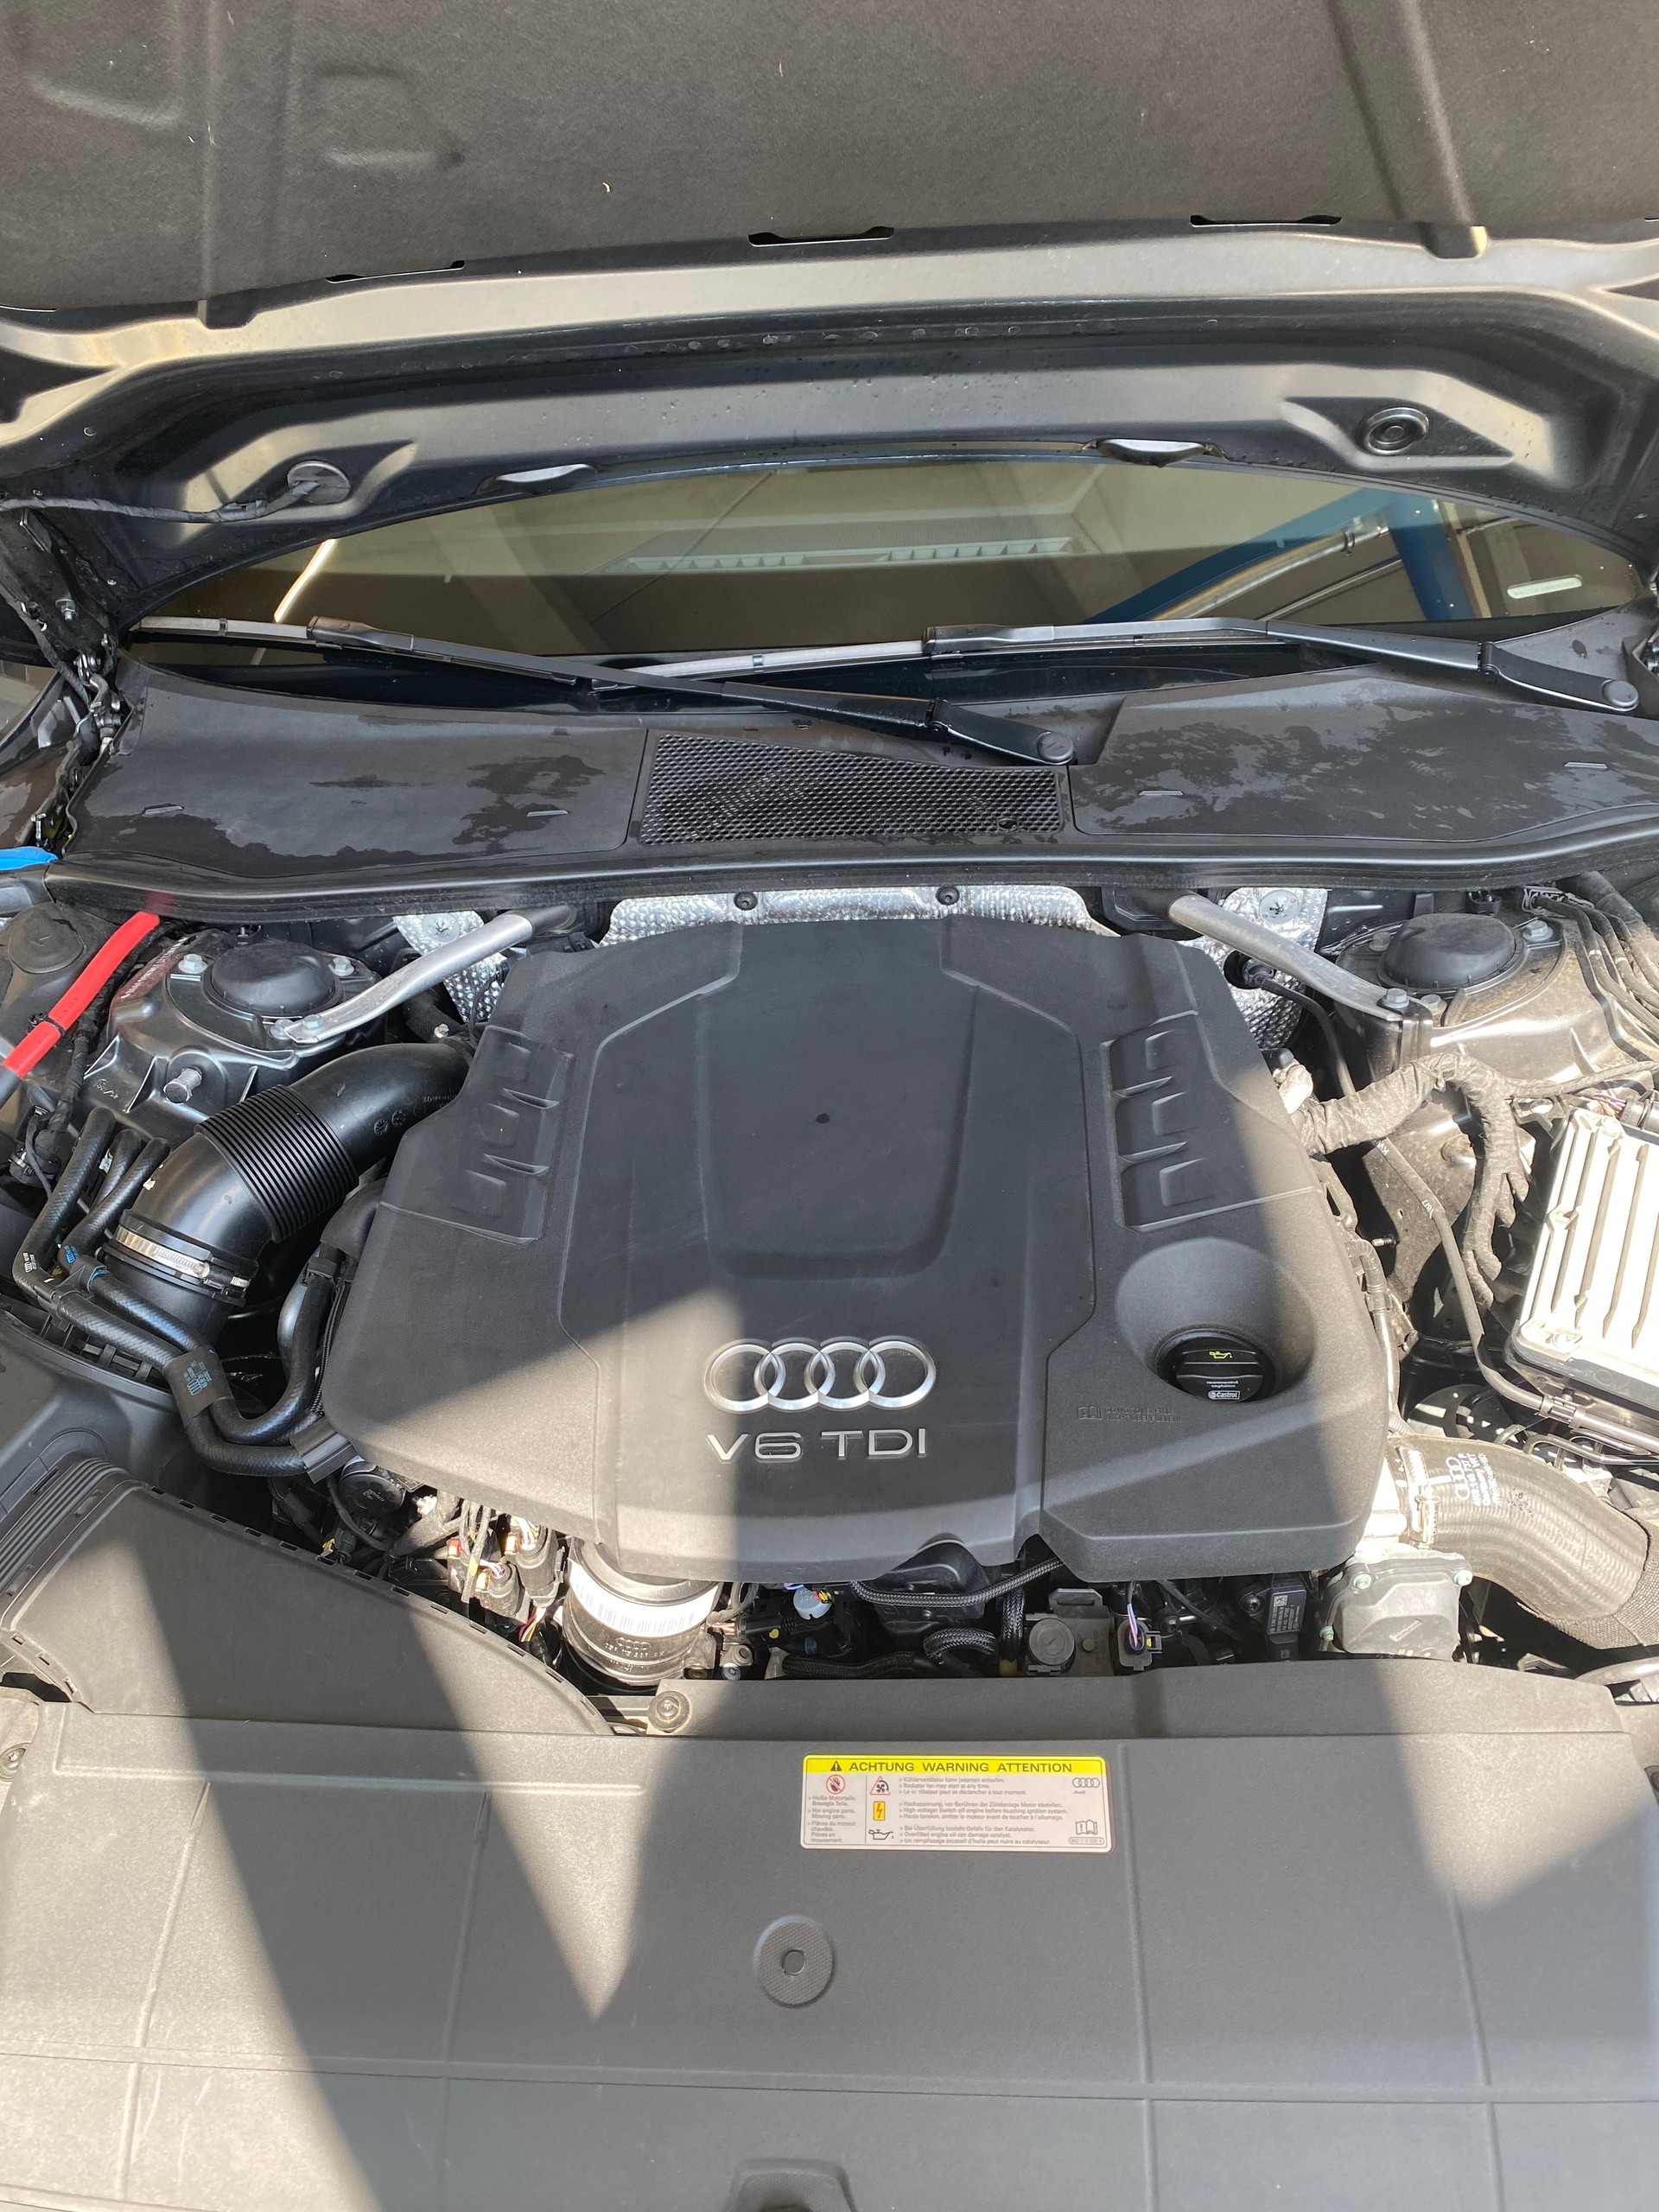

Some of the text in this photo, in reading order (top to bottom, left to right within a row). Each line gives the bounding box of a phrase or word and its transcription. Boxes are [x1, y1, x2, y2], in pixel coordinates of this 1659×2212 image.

[706, 1428, 926, 1462] V6 TDI
[849, 1762, 1072, 1773] ACHTUNG WARNING ATTENTION
